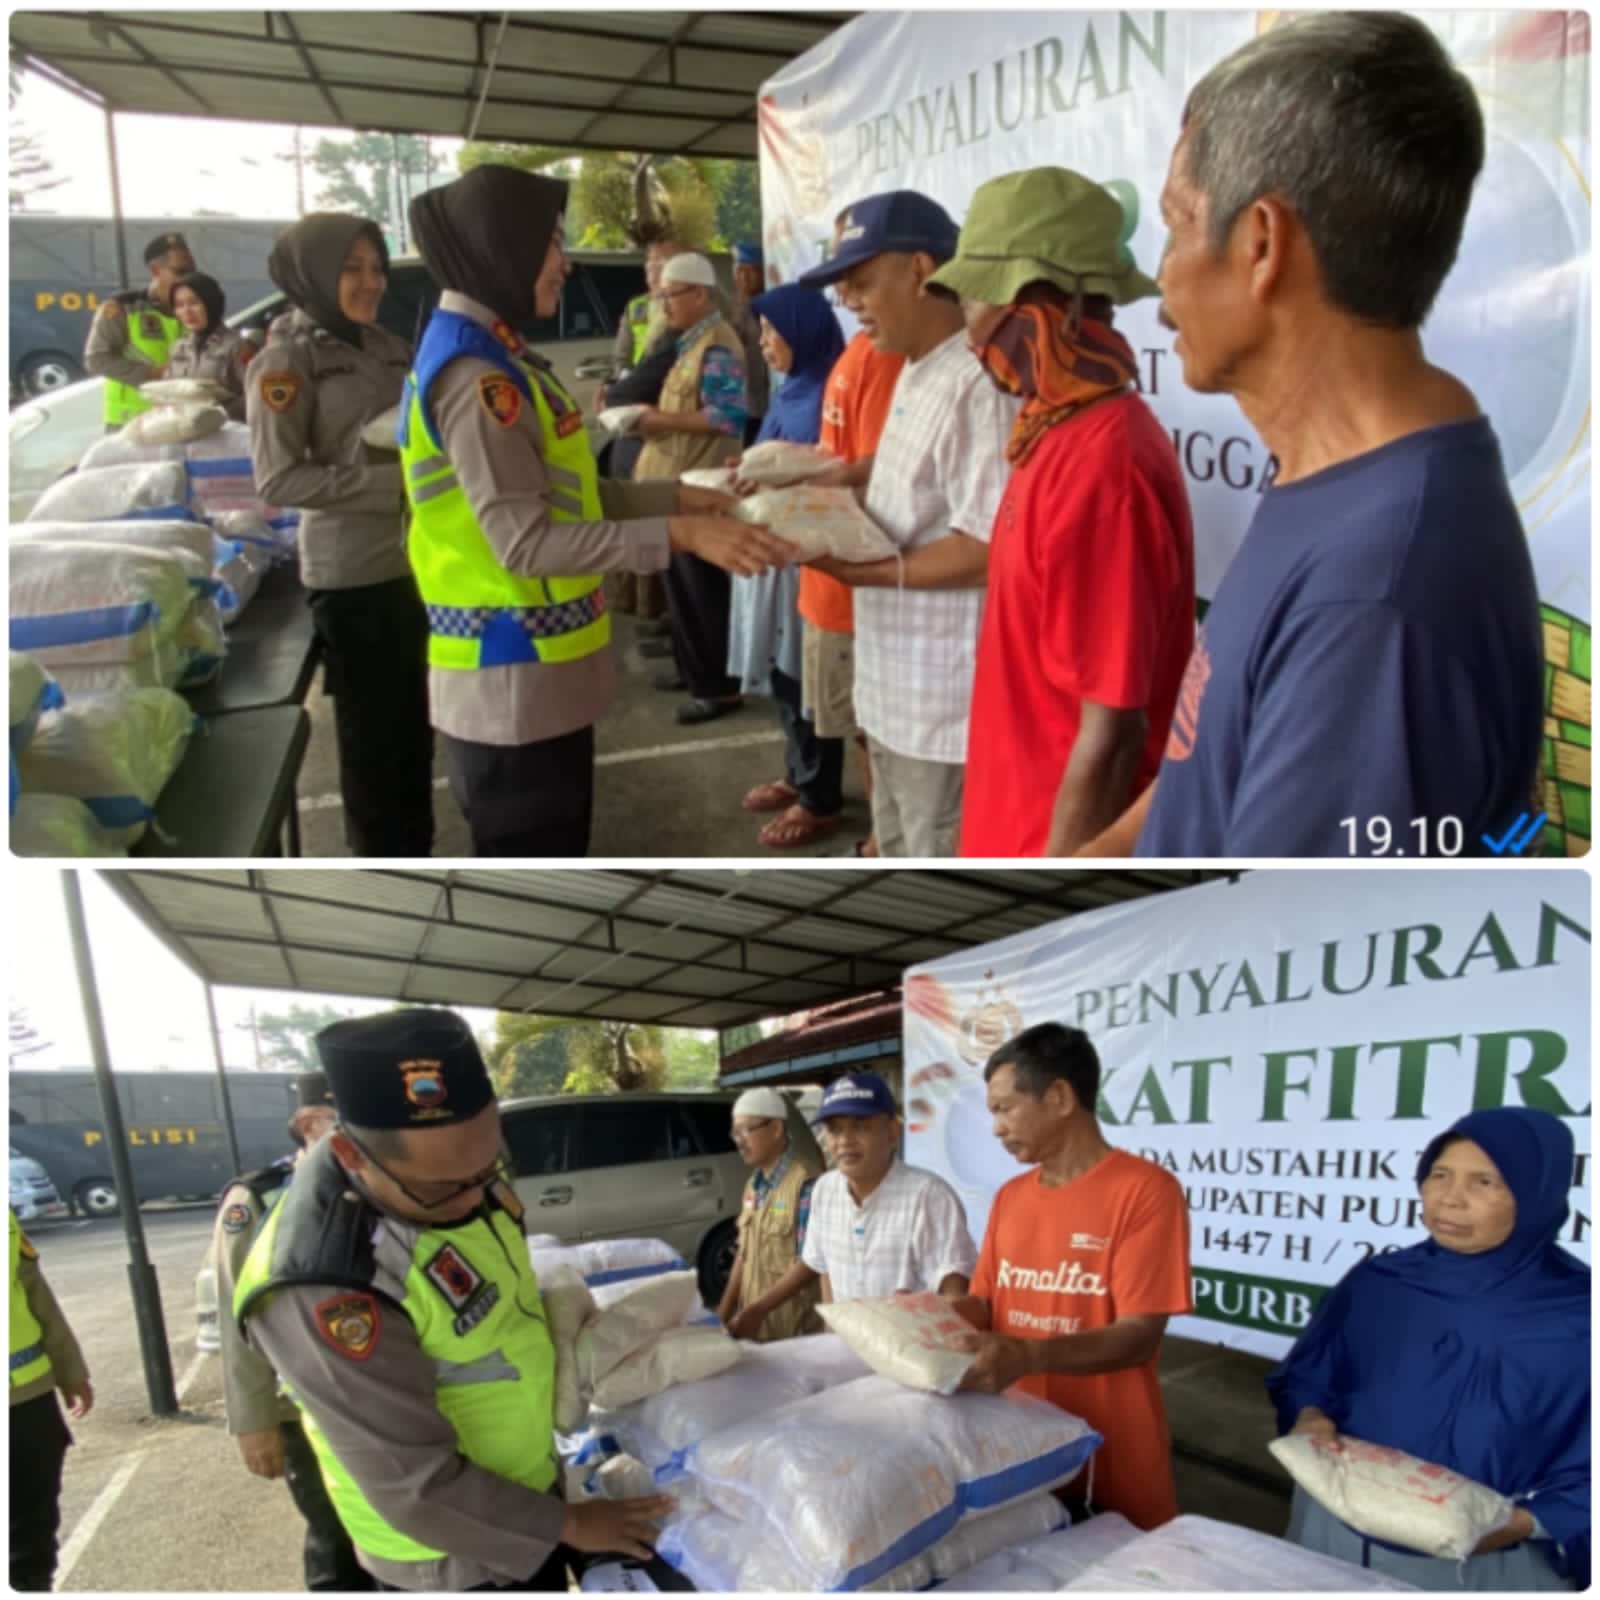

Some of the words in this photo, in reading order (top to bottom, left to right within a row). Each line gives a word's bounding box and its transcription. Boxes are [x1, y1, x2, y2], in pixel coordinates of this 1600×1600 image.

[854, 10, 1167, 175] PENYALURAN
[36, 291, 98, 312] POL
[1074, 900, 1592, 1031] PENYALURAN
[1097, 1056, 1232, 1127] KAT
[1257, 1029, 1592, 1121] FITR
[84, 1128, 195, 1147] PLISI
[1187, 1147, 1398, 1181] MUSTAHIK
[1186, 1186, 1326, 1221] UPATEN
[1203, 1226, 1272, 1256] 1447
[1283, 1234, 1311, 1263] H
[1192, 1276, 1312, 1328] PURB
